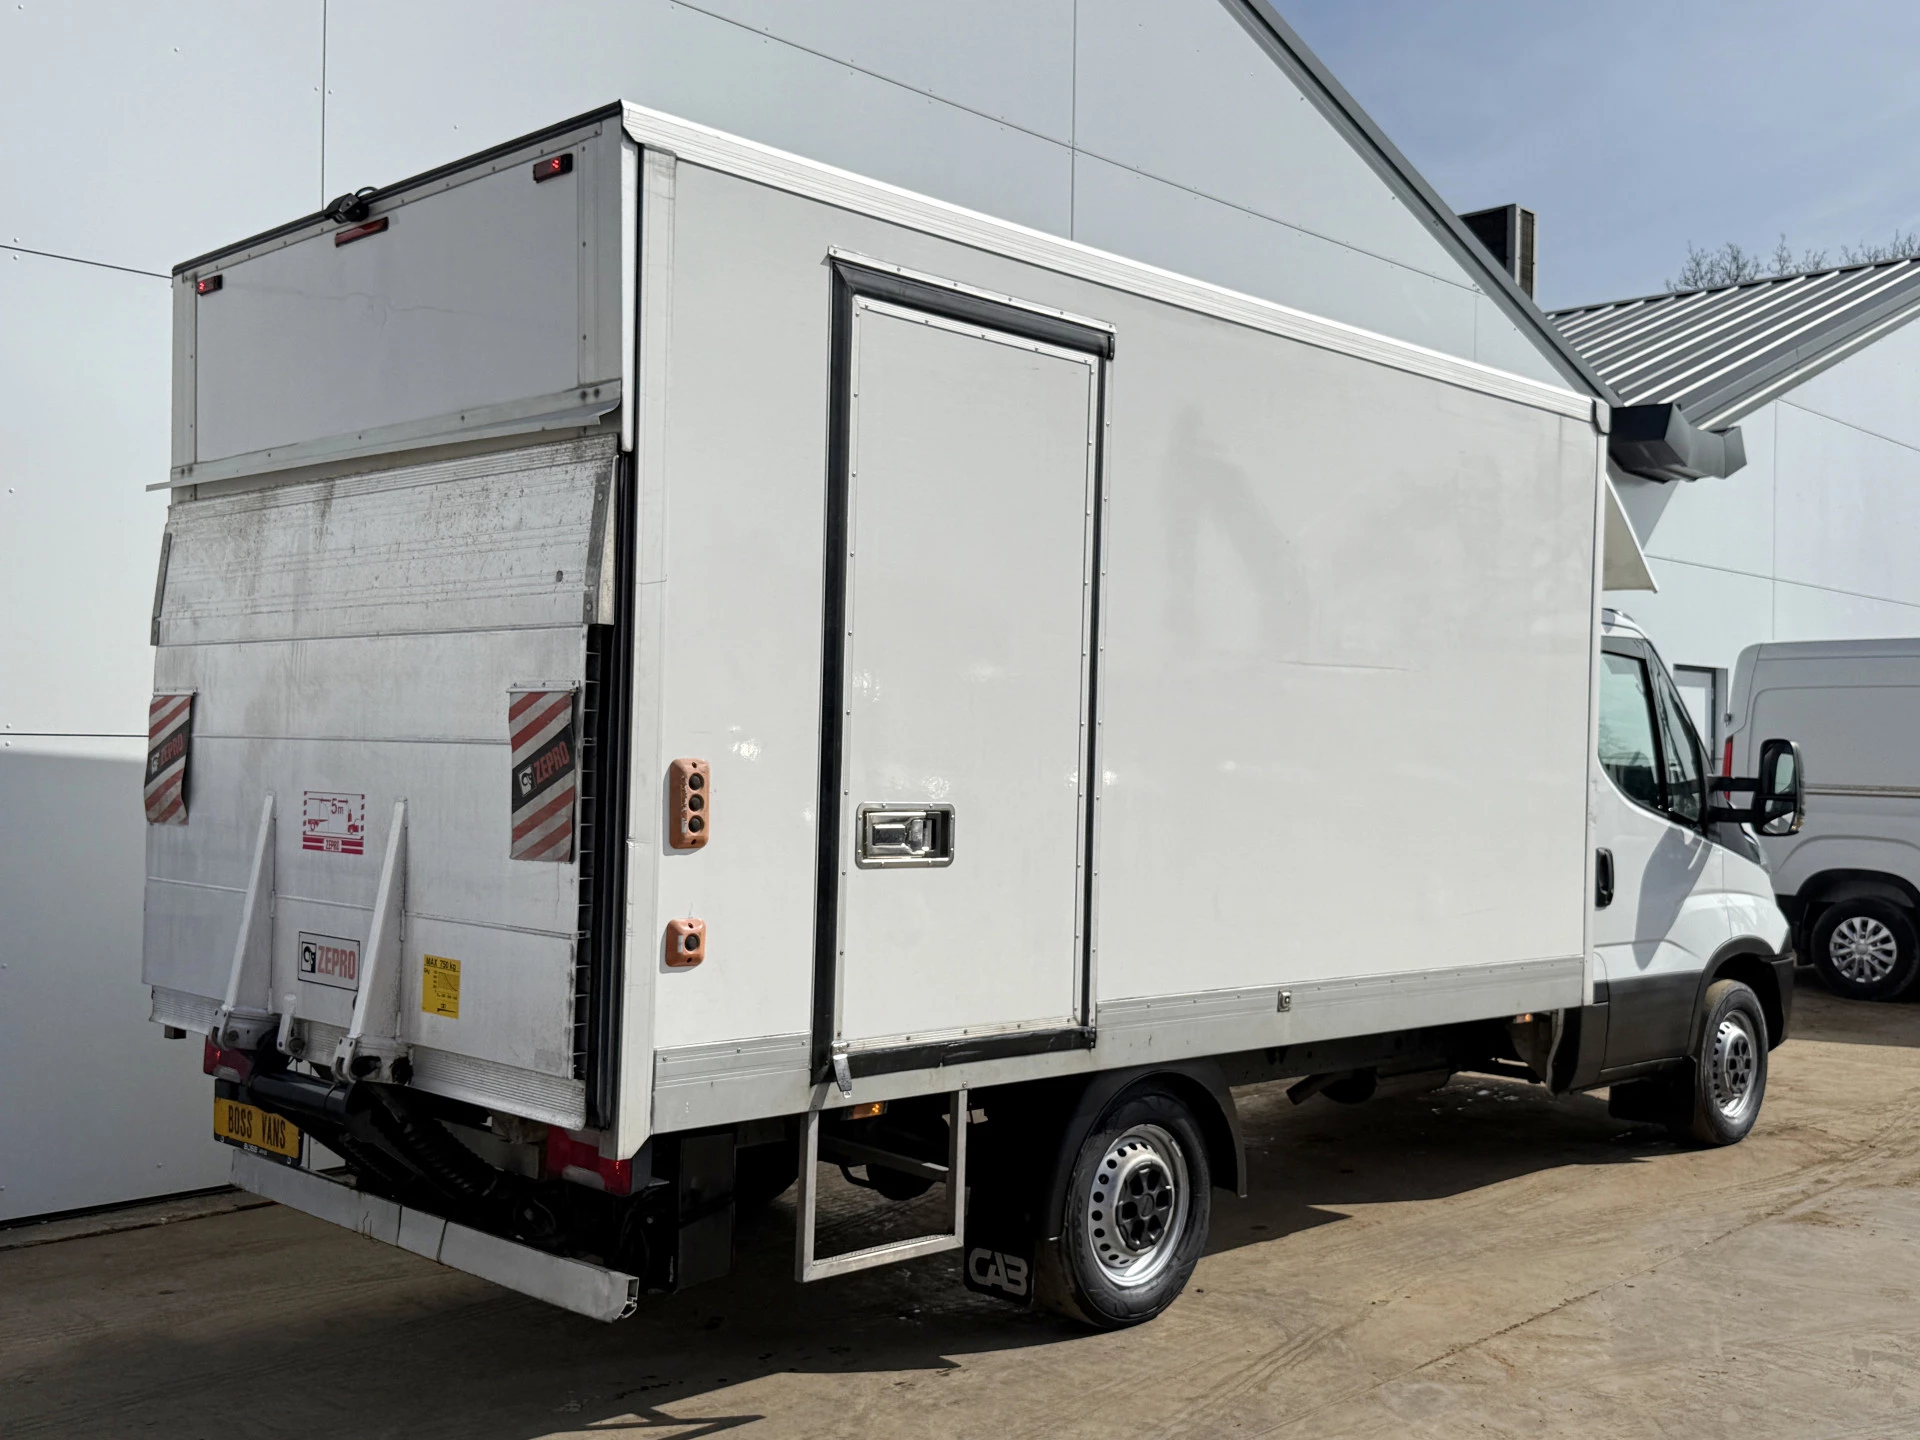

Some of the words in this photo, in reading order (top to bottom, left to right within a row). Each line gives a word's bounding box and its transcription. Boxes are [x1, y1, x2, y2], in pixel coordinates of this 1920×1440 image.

[160, 733, 184, 766] ZEPRO
[533, 741, 570, 785] ZEPRO
[317, 945, 357, 980] ZEPRO
[228, 1105, 253, 1139] BOSS
[262, 1112, 286, 1149] VANS
[968, 1247, 1028, 1296] CAB
